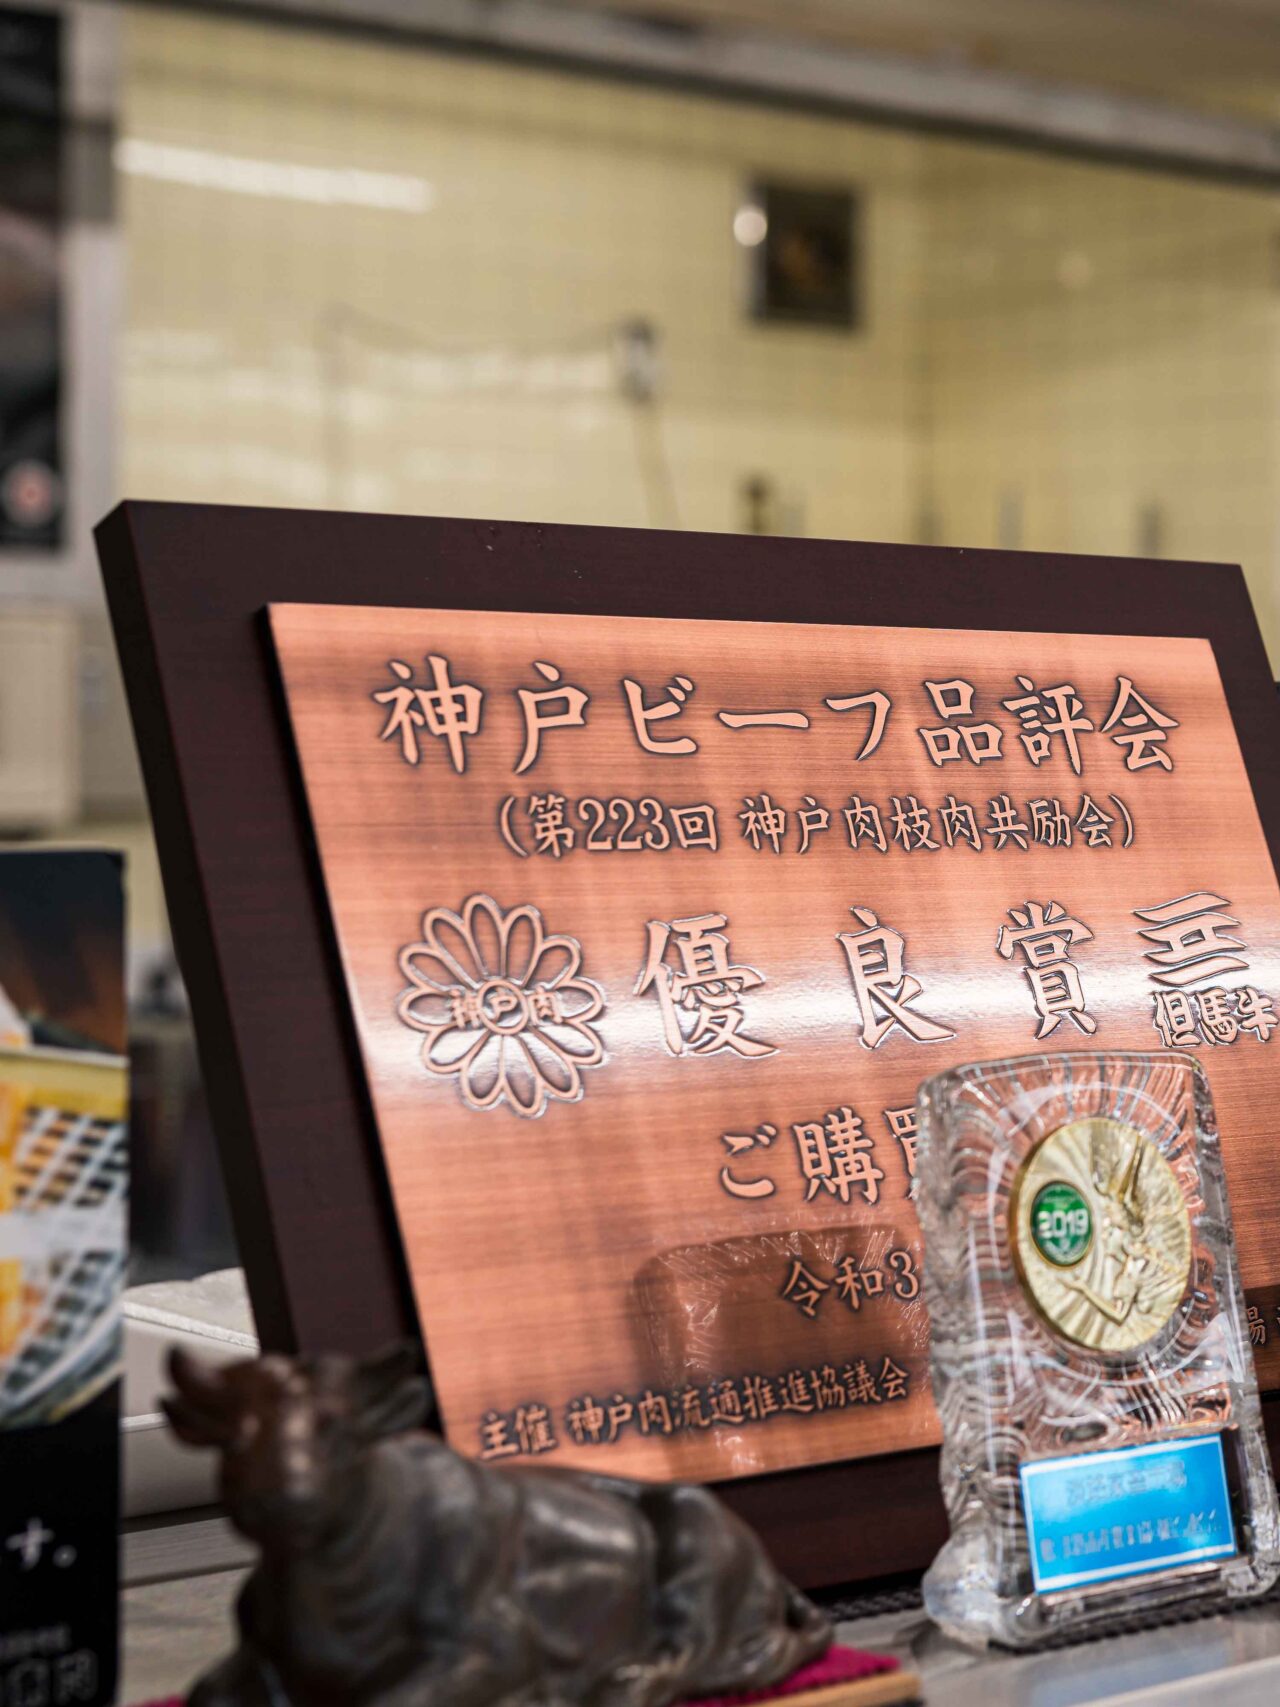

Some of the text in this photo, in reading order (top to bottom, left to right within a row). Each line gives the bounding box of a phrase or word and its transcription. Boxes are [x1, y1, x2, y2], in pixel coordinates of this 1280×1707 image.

[371, 654, 1181, 776] 神戸ビーフ品評会
[1150, 986, 1280, 1048] 但馬牛
[1037, 1208, 1089, 1239] 2019
[480, 1356, 910, 1461] 主催 神戸肉流通推進協議会
